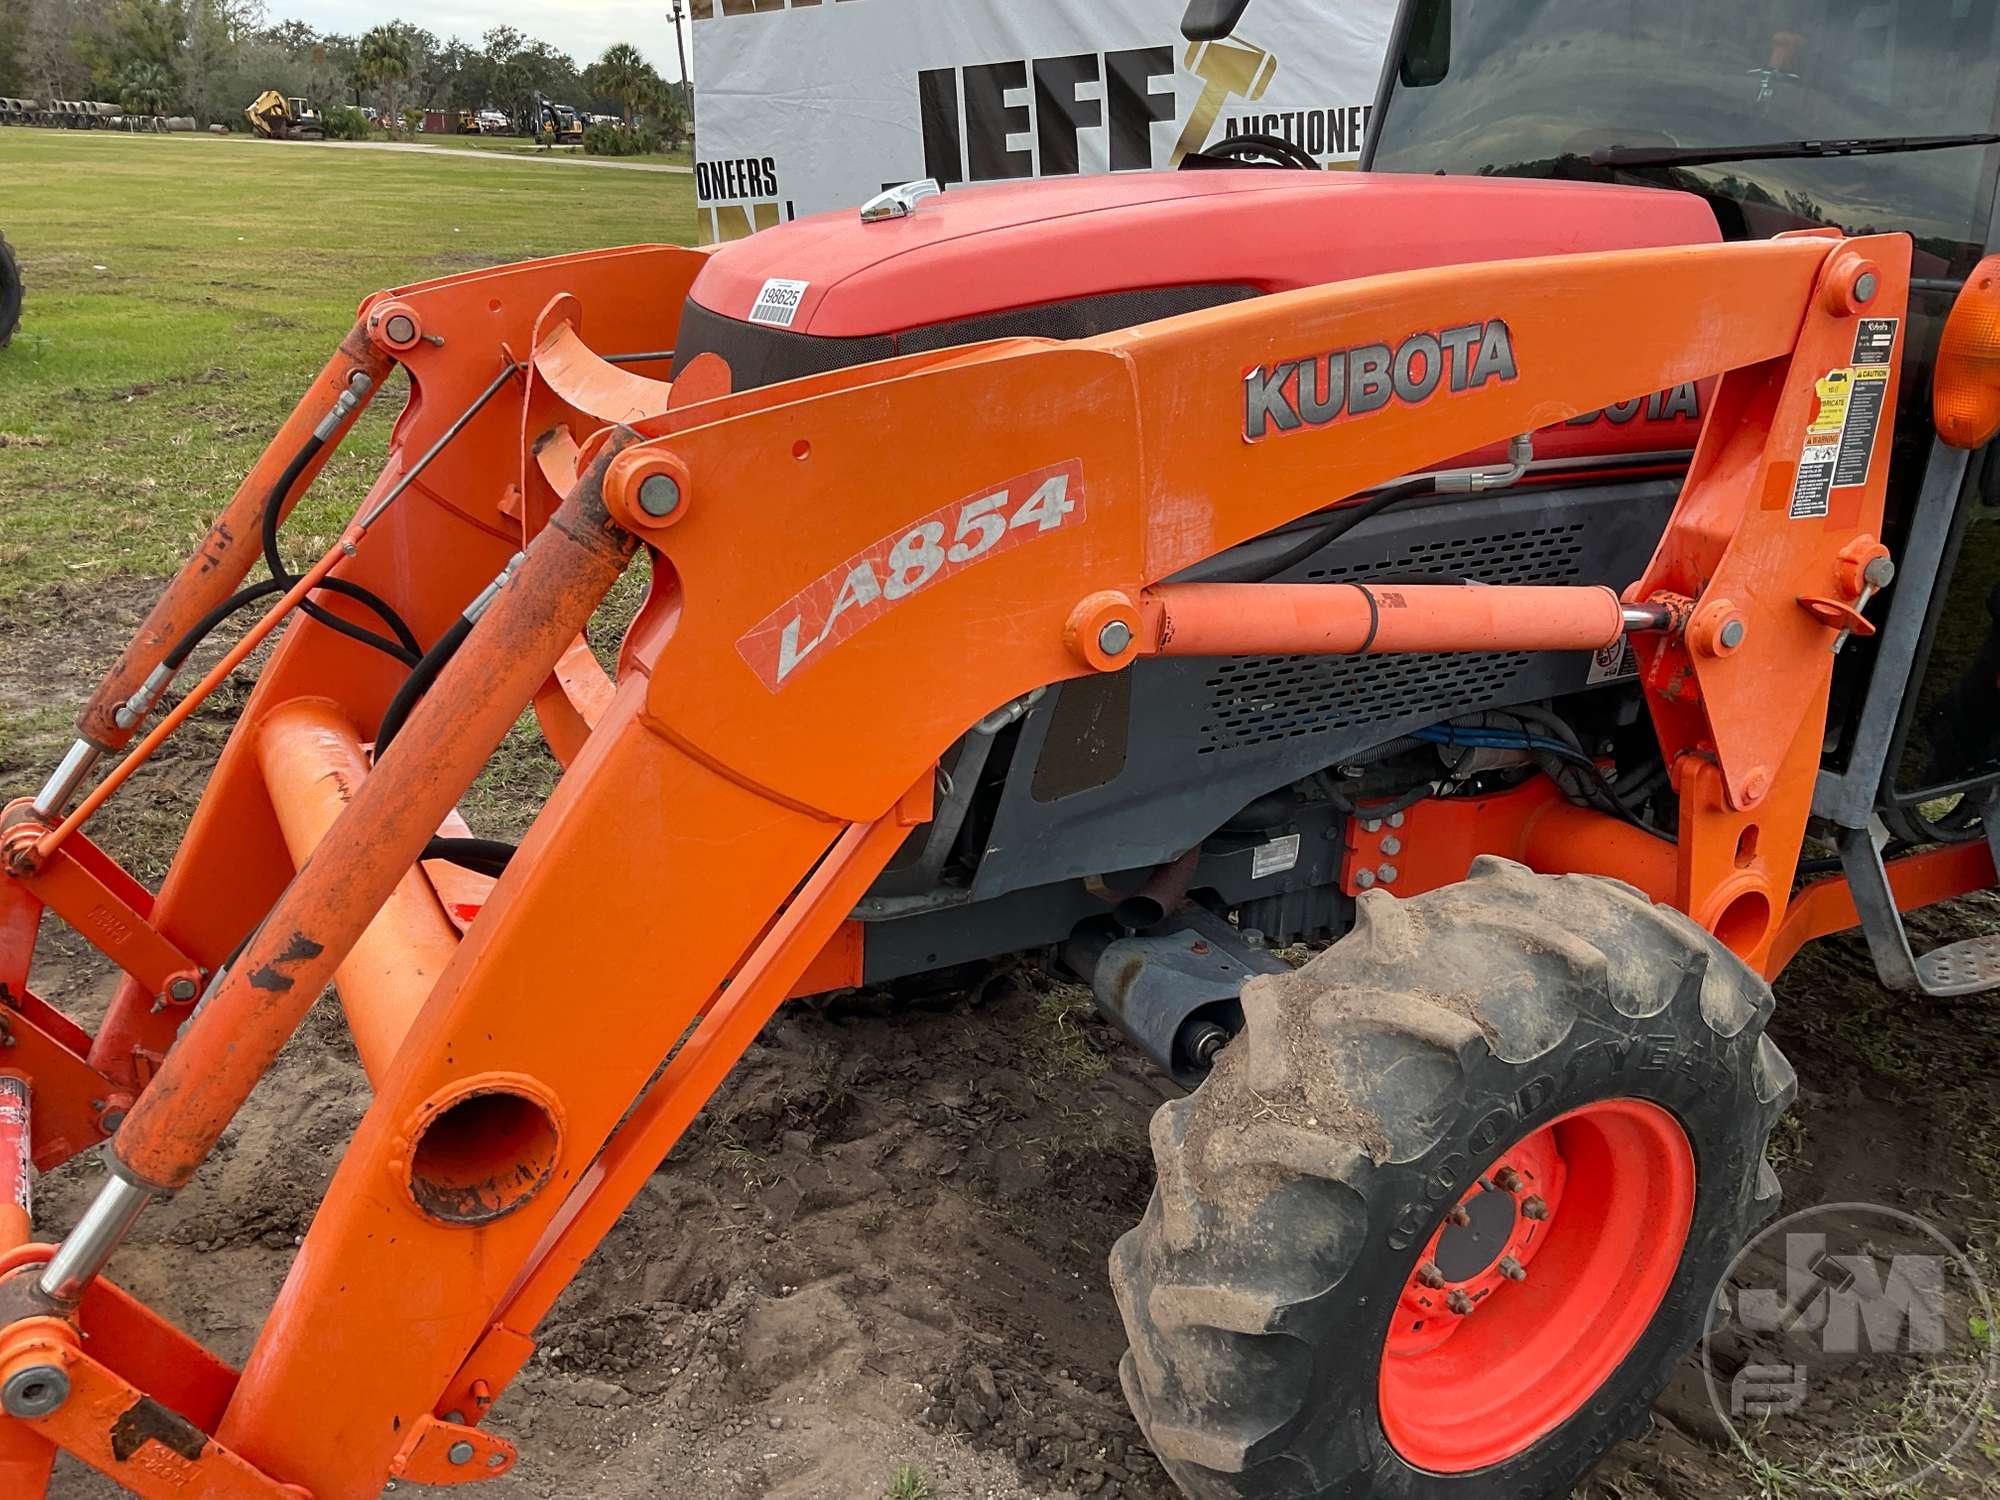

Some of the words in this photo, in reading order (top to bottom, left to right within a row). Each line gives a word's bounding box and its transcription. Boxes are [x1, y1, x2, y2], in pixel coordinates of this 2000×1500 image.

[881, 45, 1176, 192] JEFF
[696, 156, 778, 201] ONEERS
[761, 287, 801, 307] 198625
[1245, 319, 1518, 438] KUBOTA
[1862, 370, 1888, 378] CAUTION
[776, 473, 1076, 684] LA854
